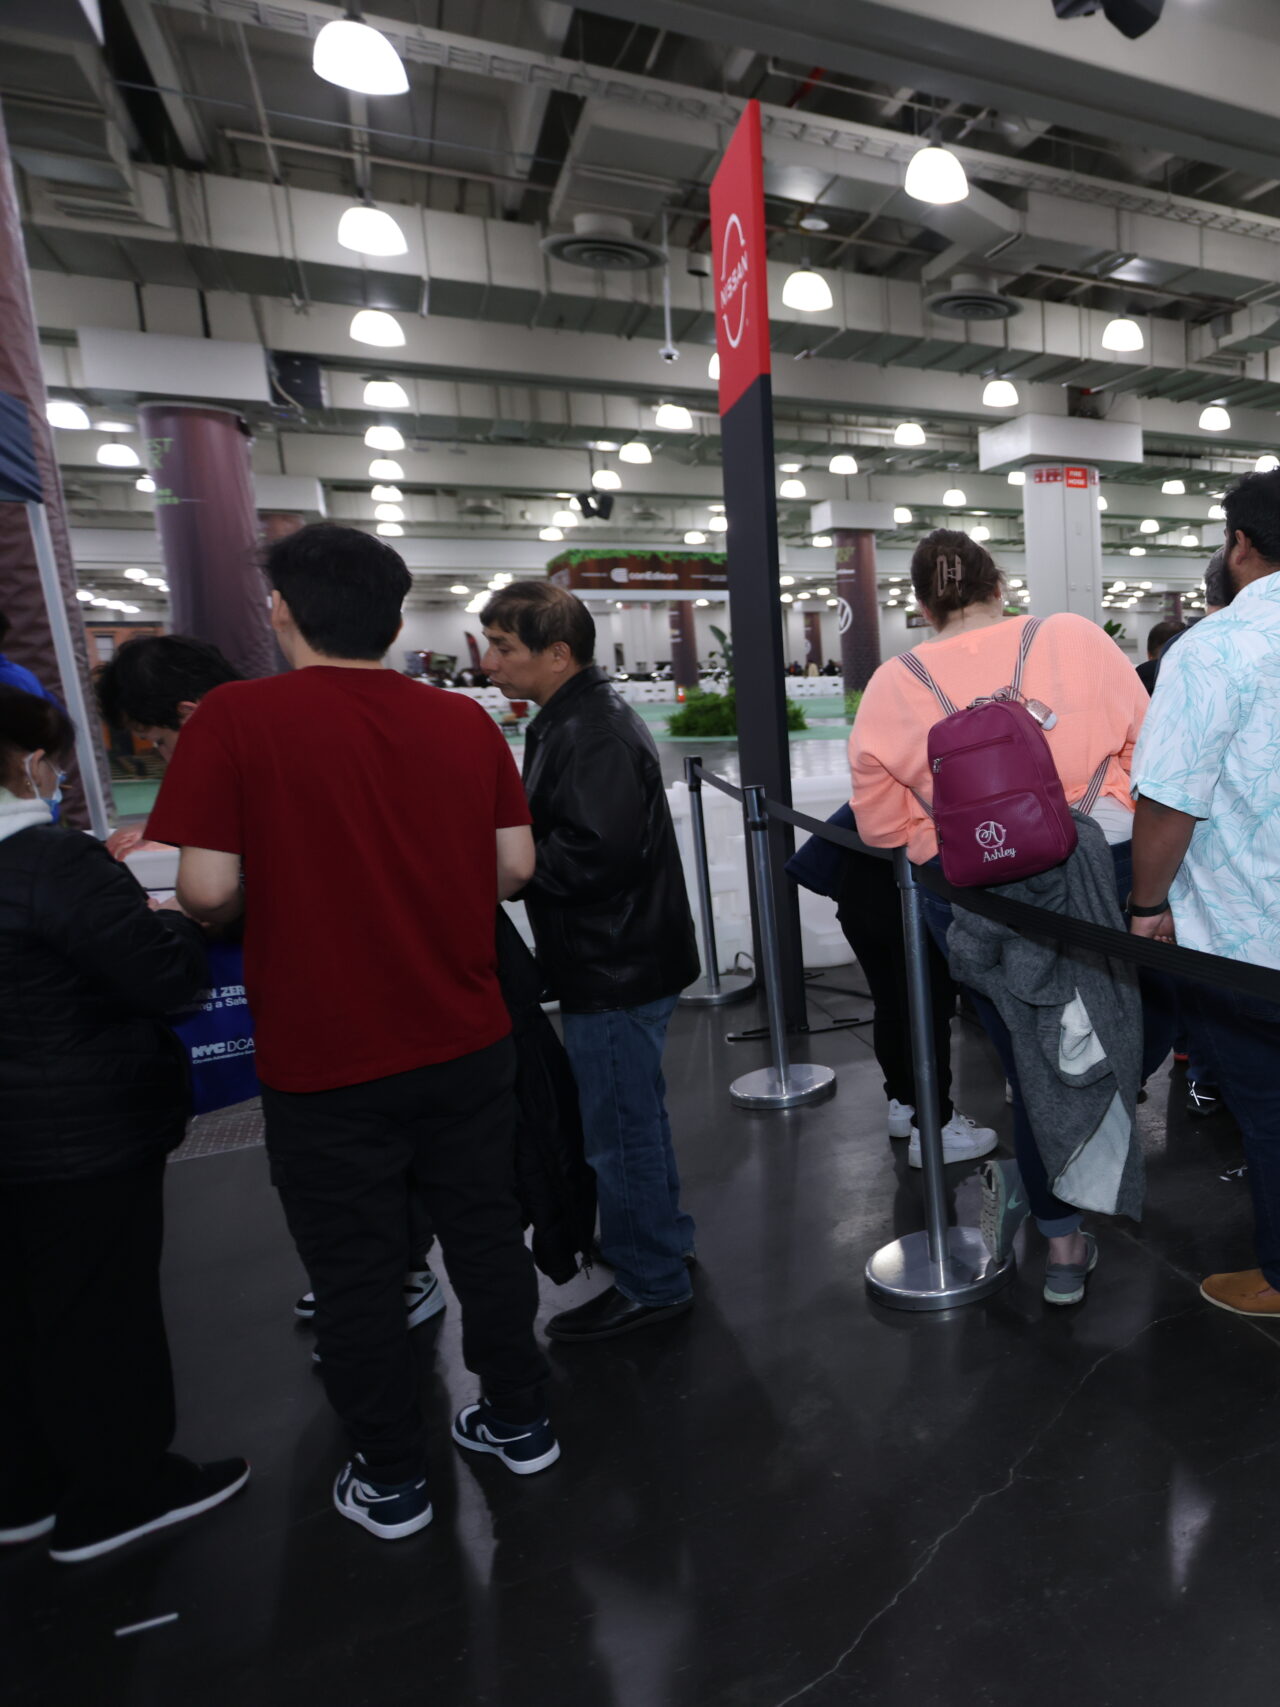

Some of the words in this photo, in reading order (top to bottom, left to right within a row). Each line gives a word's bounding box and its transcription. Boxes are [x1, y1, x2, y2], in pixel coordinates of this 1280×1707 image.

[720, 250, 748, 308] NISSAN
[983, 847, 1016, 862] Ashley
[192, 1042, 226, 1059] NYC
